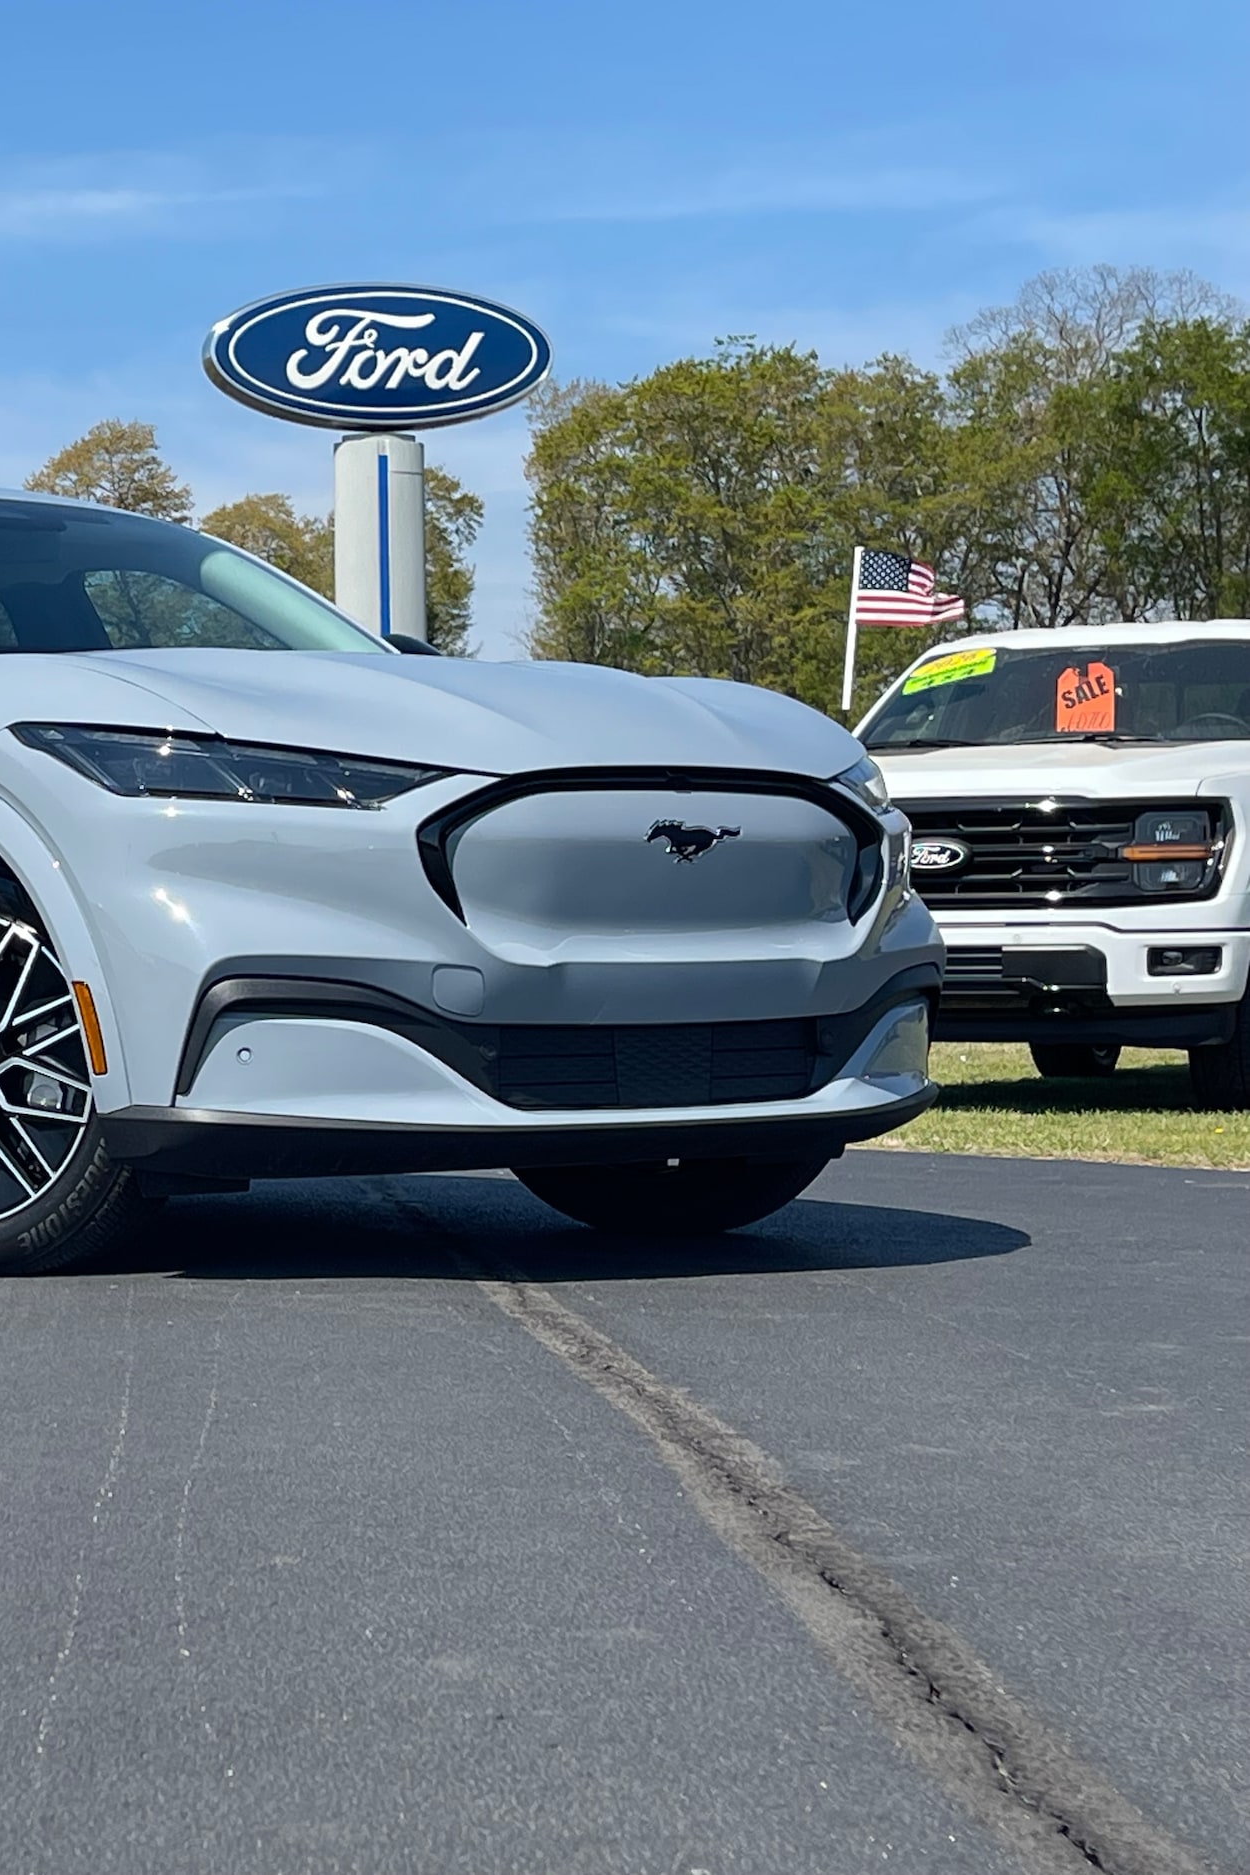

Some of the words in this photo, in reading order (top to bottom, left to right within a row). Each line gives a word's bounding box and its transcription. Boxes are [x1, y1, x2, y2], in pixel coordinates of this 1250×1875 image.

[286, 309, 485, 391] Ford
[1061, 674, 1110, 709] SALE
[911, 846, 951, 864] Ford
